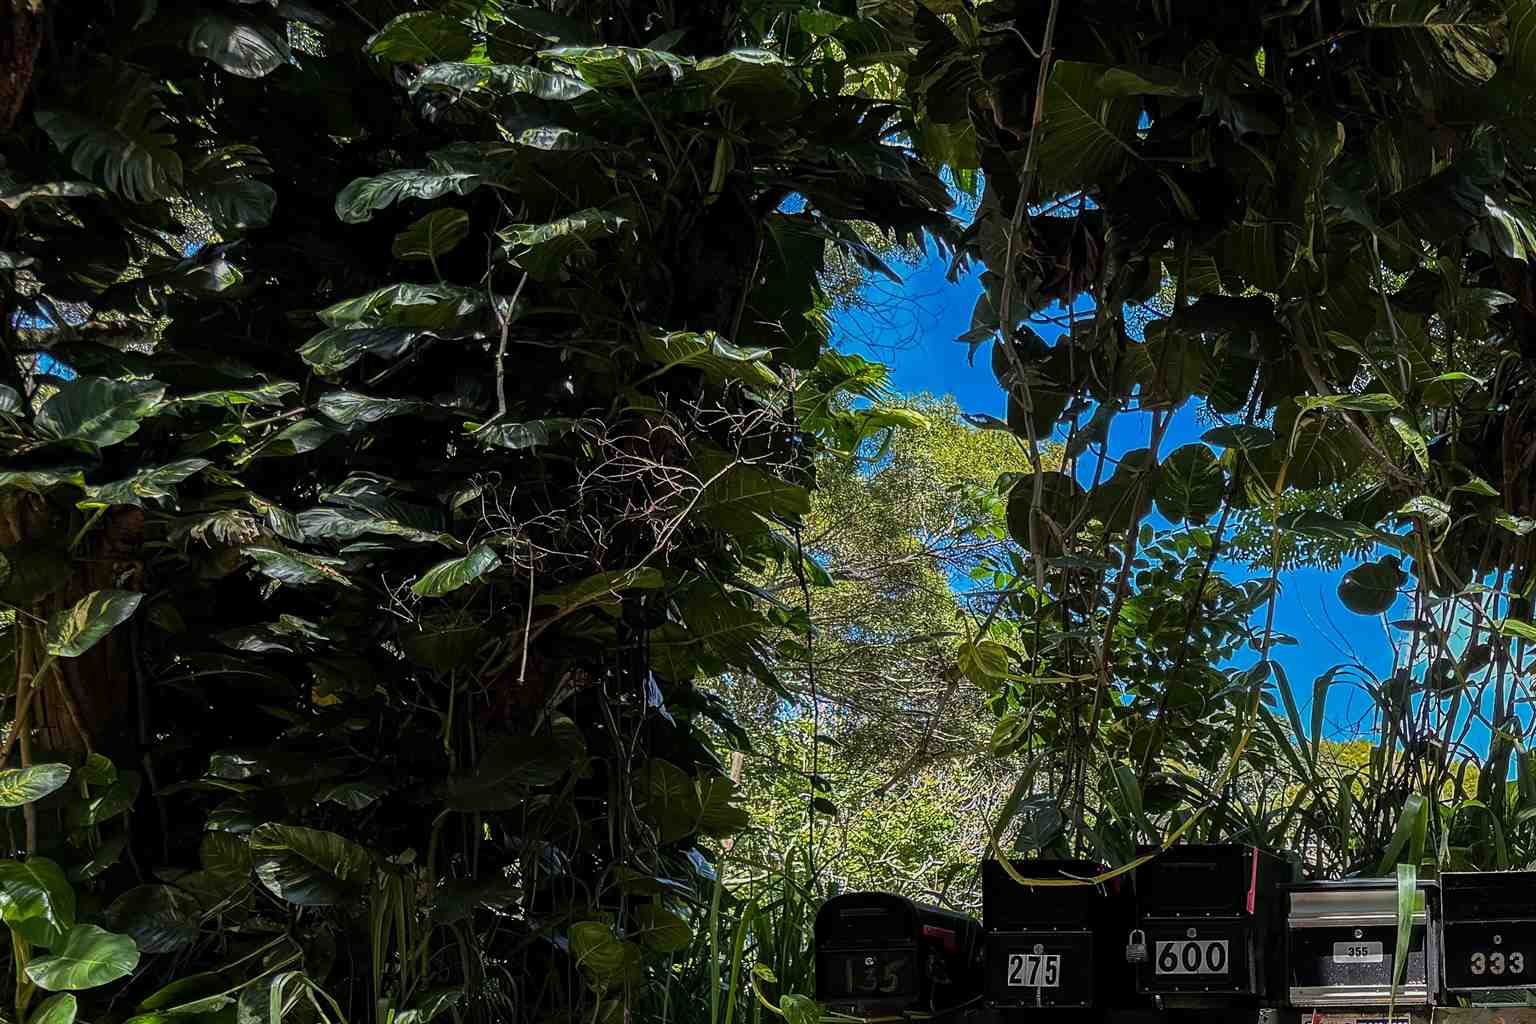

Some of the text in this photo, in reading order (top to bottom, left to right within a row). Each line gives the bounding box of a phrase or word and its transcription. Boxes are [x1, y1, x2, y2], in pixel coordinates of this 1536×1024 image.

[1158, 942, 1226, 972] 600
[1347, 946, 1368, 957] 355
[1470, 952, 1524, 975] 333
[1009, 955, 1058, 984] 275
